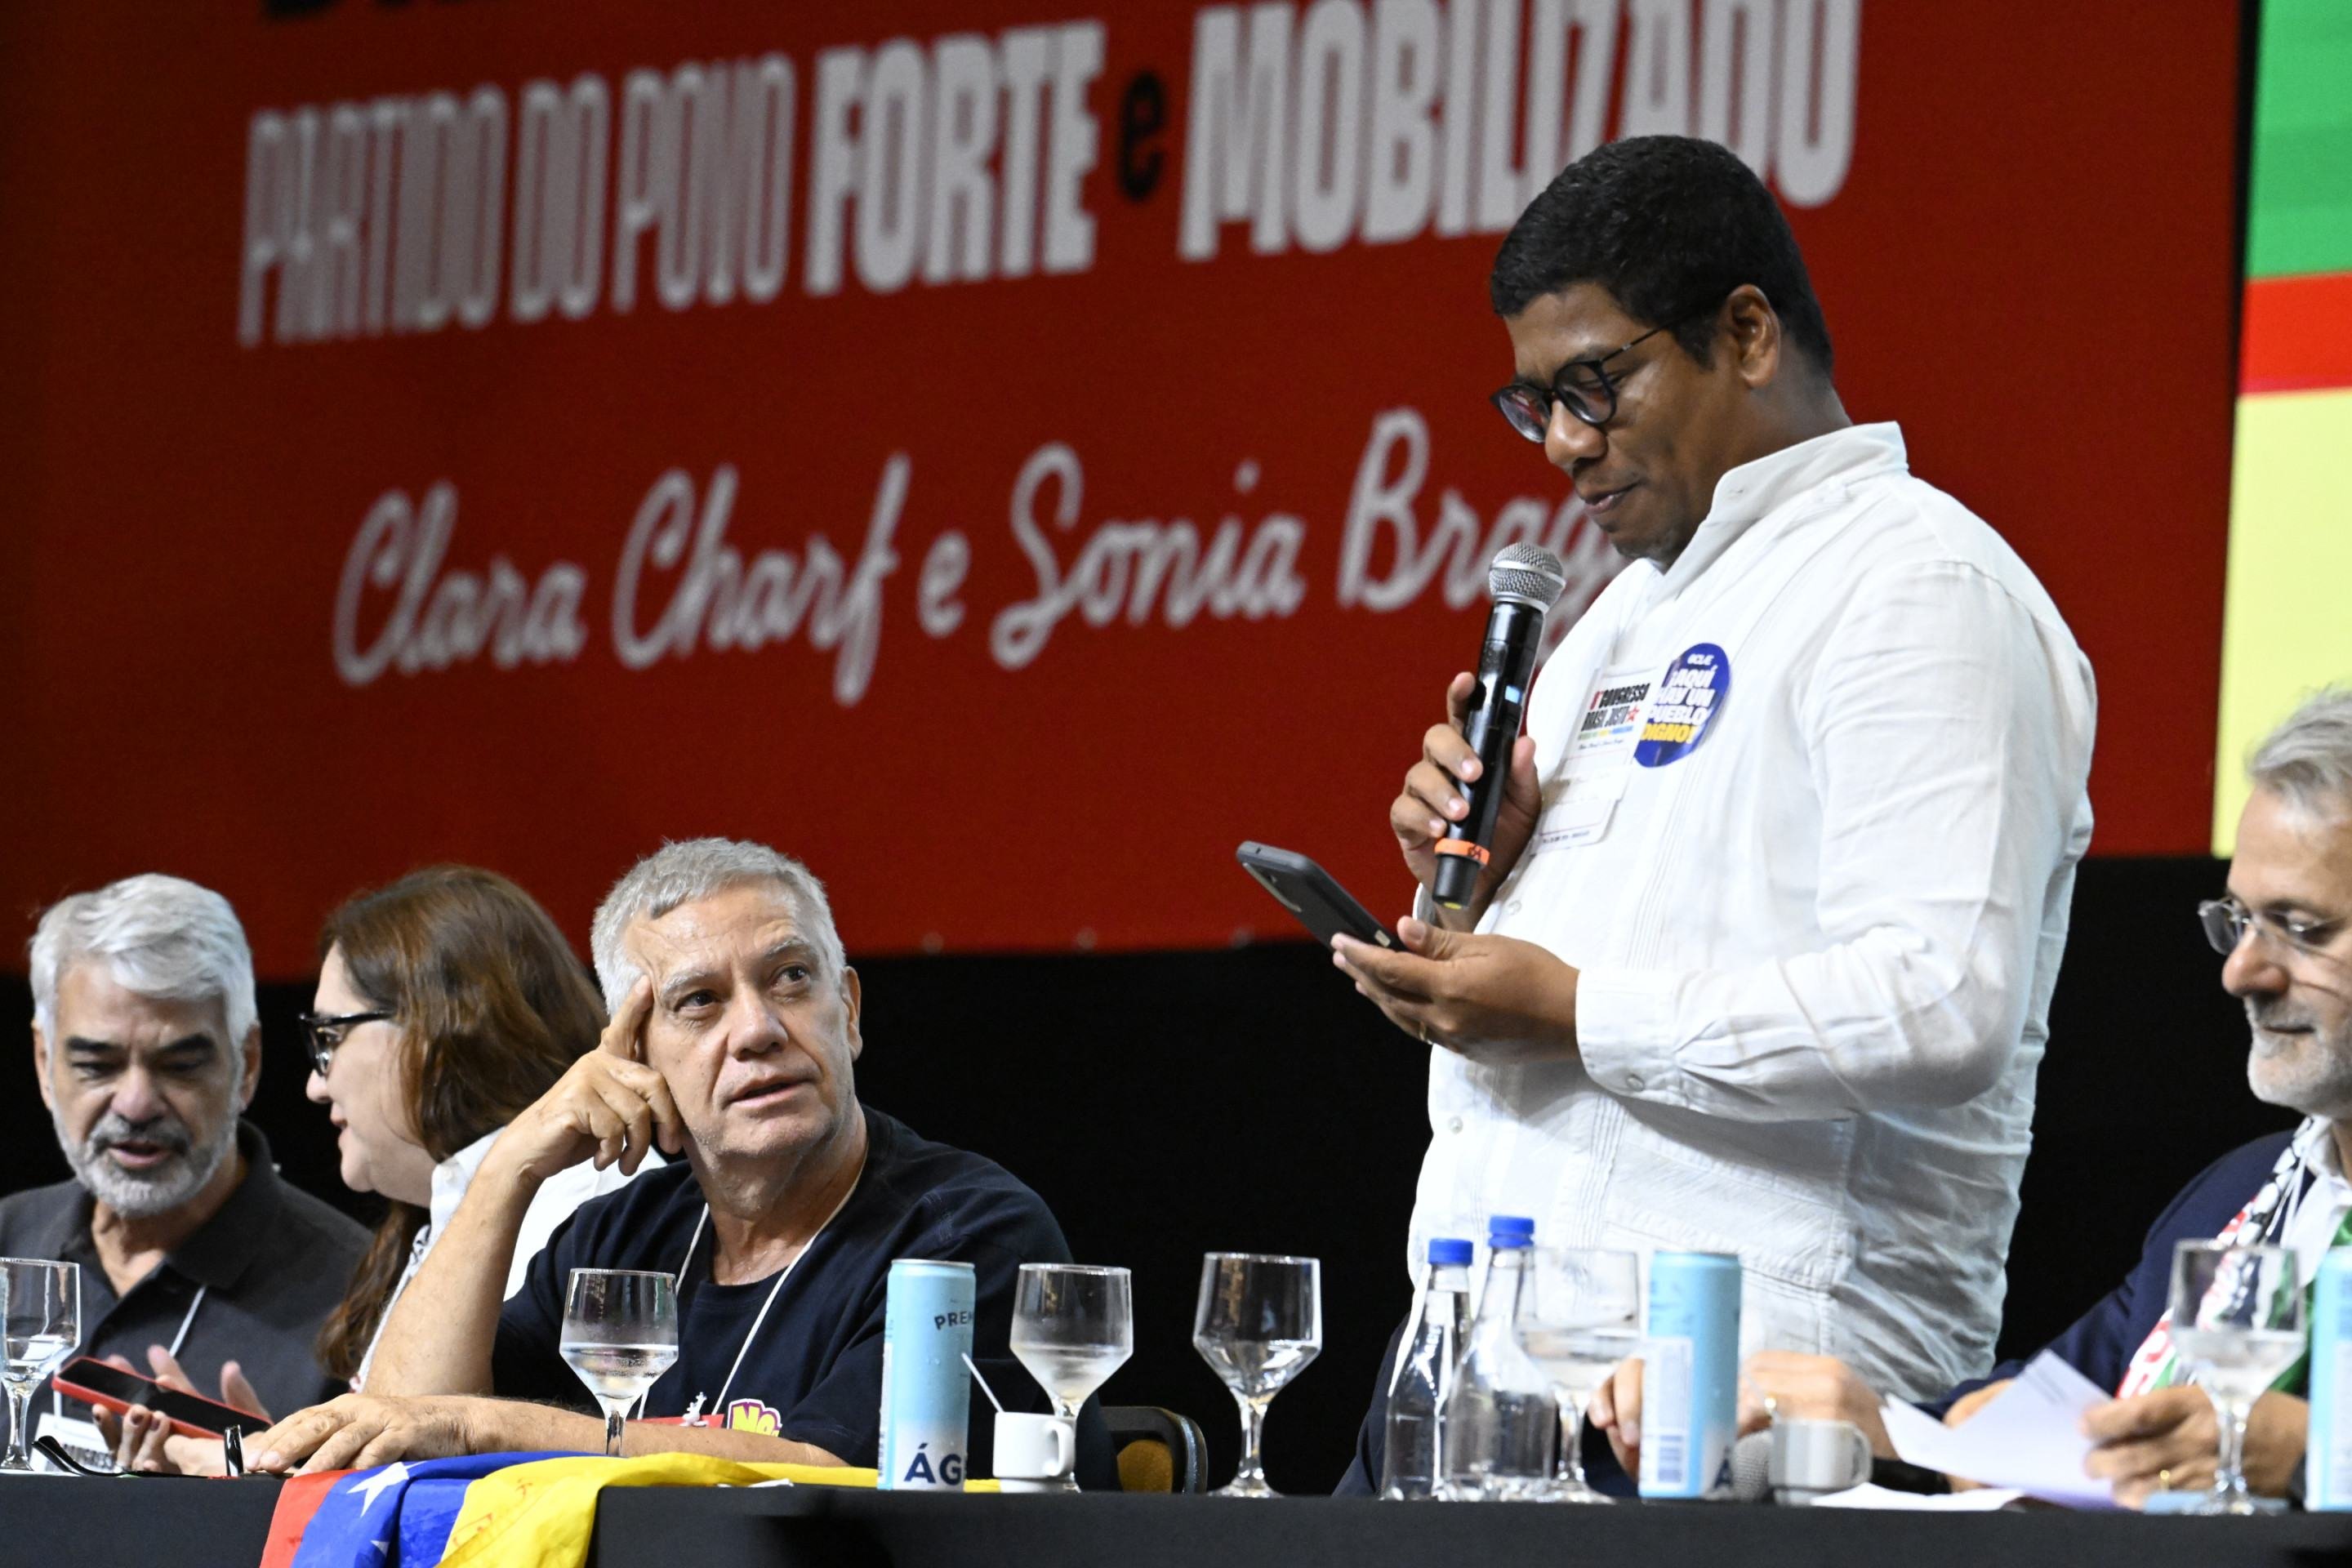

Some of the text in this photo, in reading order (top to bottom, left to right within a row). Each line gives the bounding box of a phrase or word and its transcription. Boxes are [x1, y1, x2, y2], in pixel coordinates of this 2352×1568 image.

[238, 85, 508, 348] PARTIDO
[510, 72, 610, 320] DO
[804, 18, 1107, 297] FORTE
[1116, 69, 1169, 206] e
[333, 406, 1621, 707] Clara Charf e Sonia Brag
